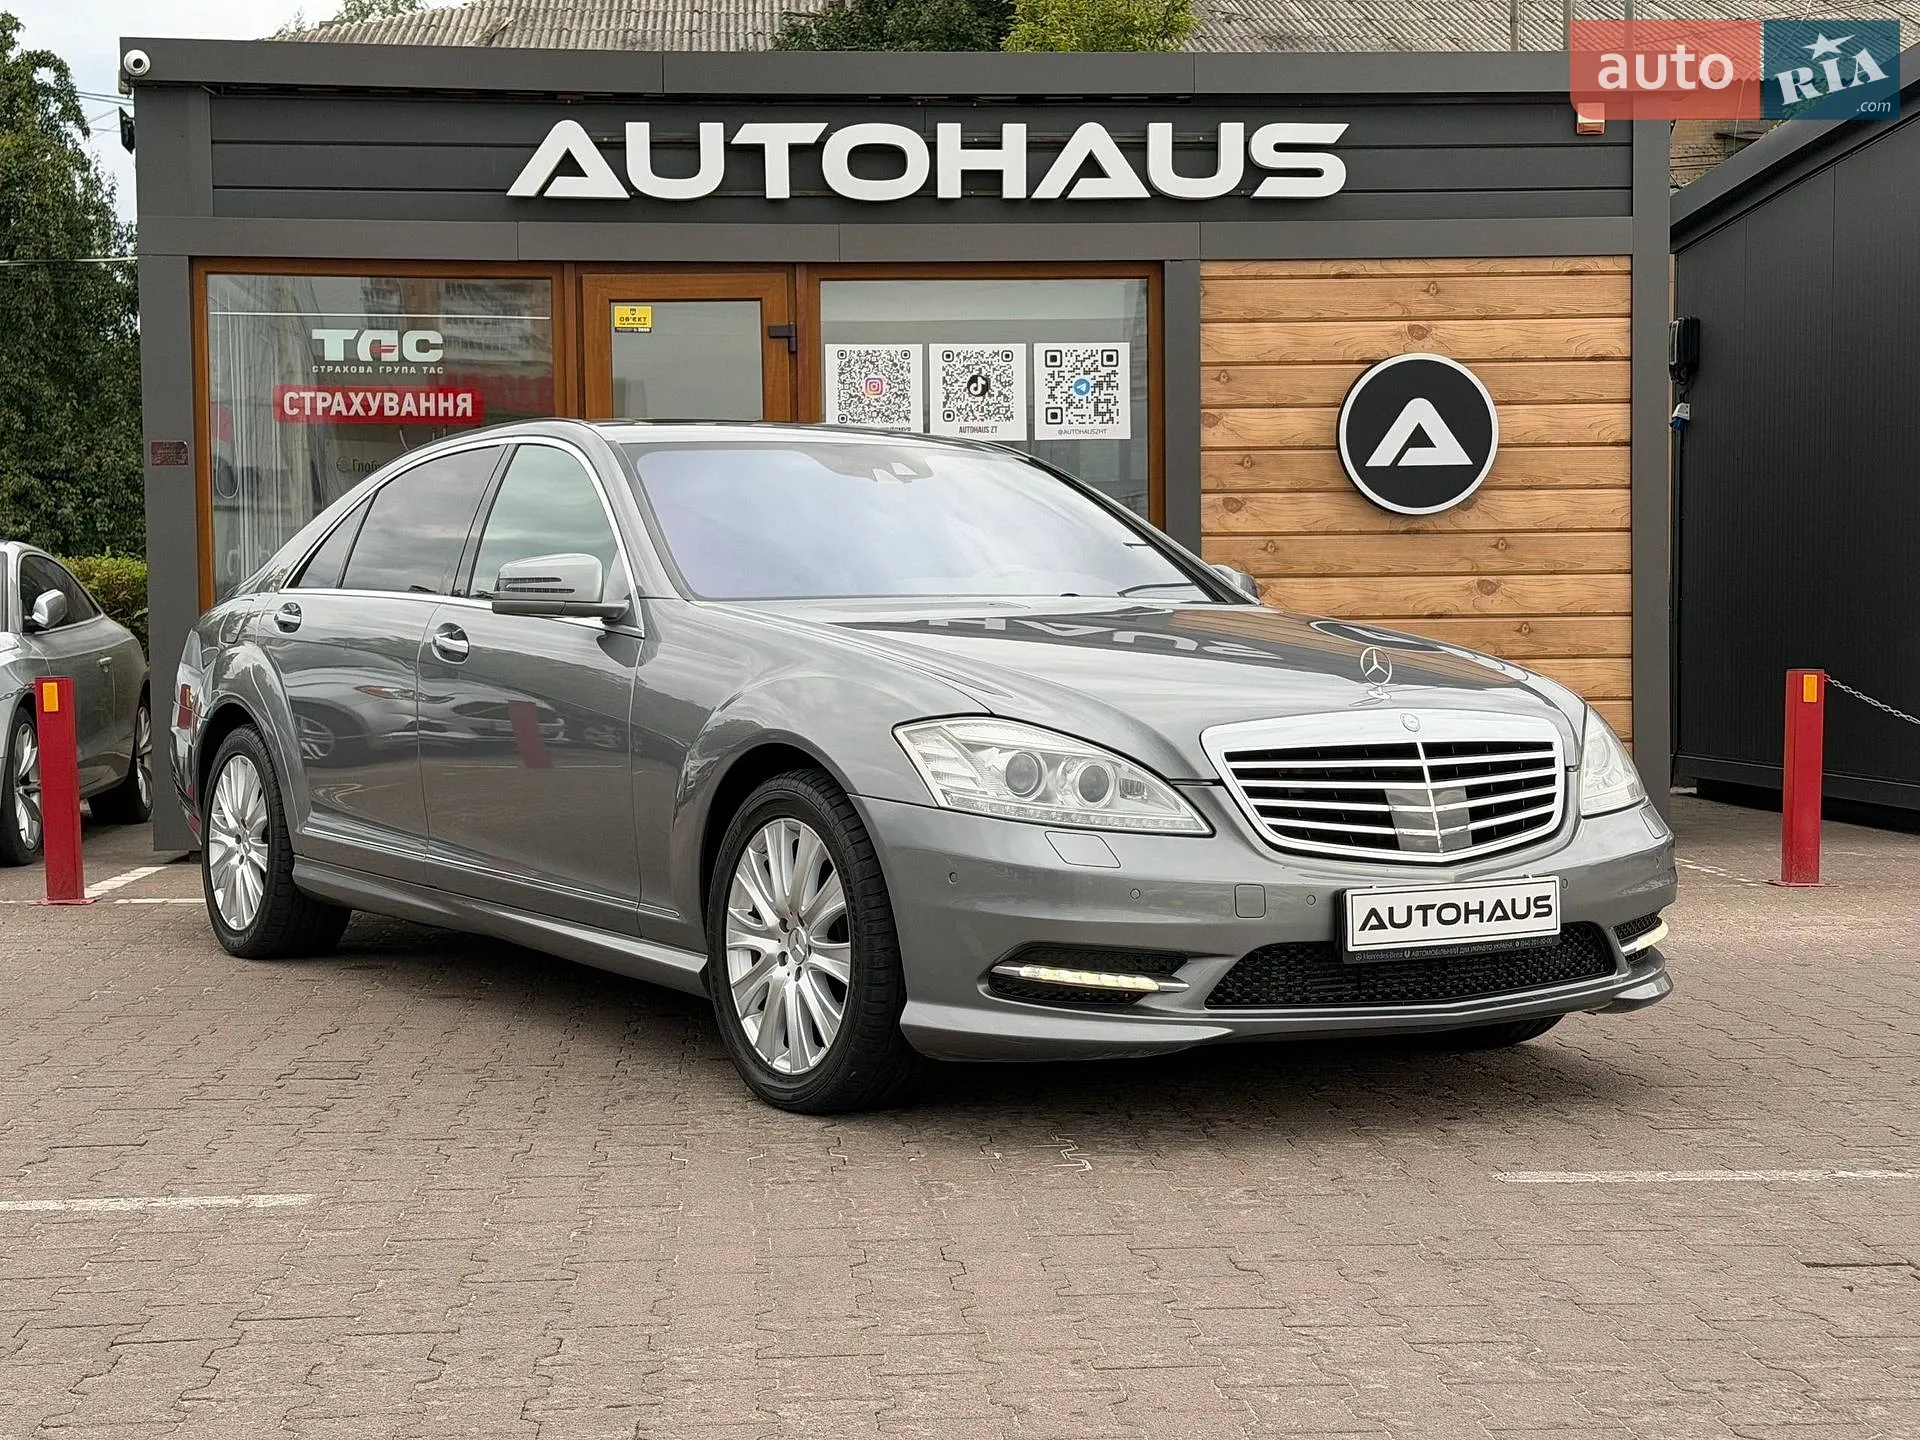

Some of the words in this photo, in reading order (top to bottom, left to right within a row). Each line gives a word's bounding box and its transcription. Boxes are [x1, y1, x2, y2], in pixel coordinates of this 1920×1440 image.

[506, 119, 1350, 201] AUTOHAUS
[312, 365, 373, 374] СТРАХОВА
[379, 365, 416, 374] ГРУПА
[422, 366, 444, 374] ТАС
[283, 391, 473, 417] СТРАХУВАННЯ
[959, 425, 989, 434] AUTOHAUS
[990, 425, 998, 433] ZT
[352, 459, 380, 472] Глоб
[1358, 894, 1553, 932] AUTOHAUS
